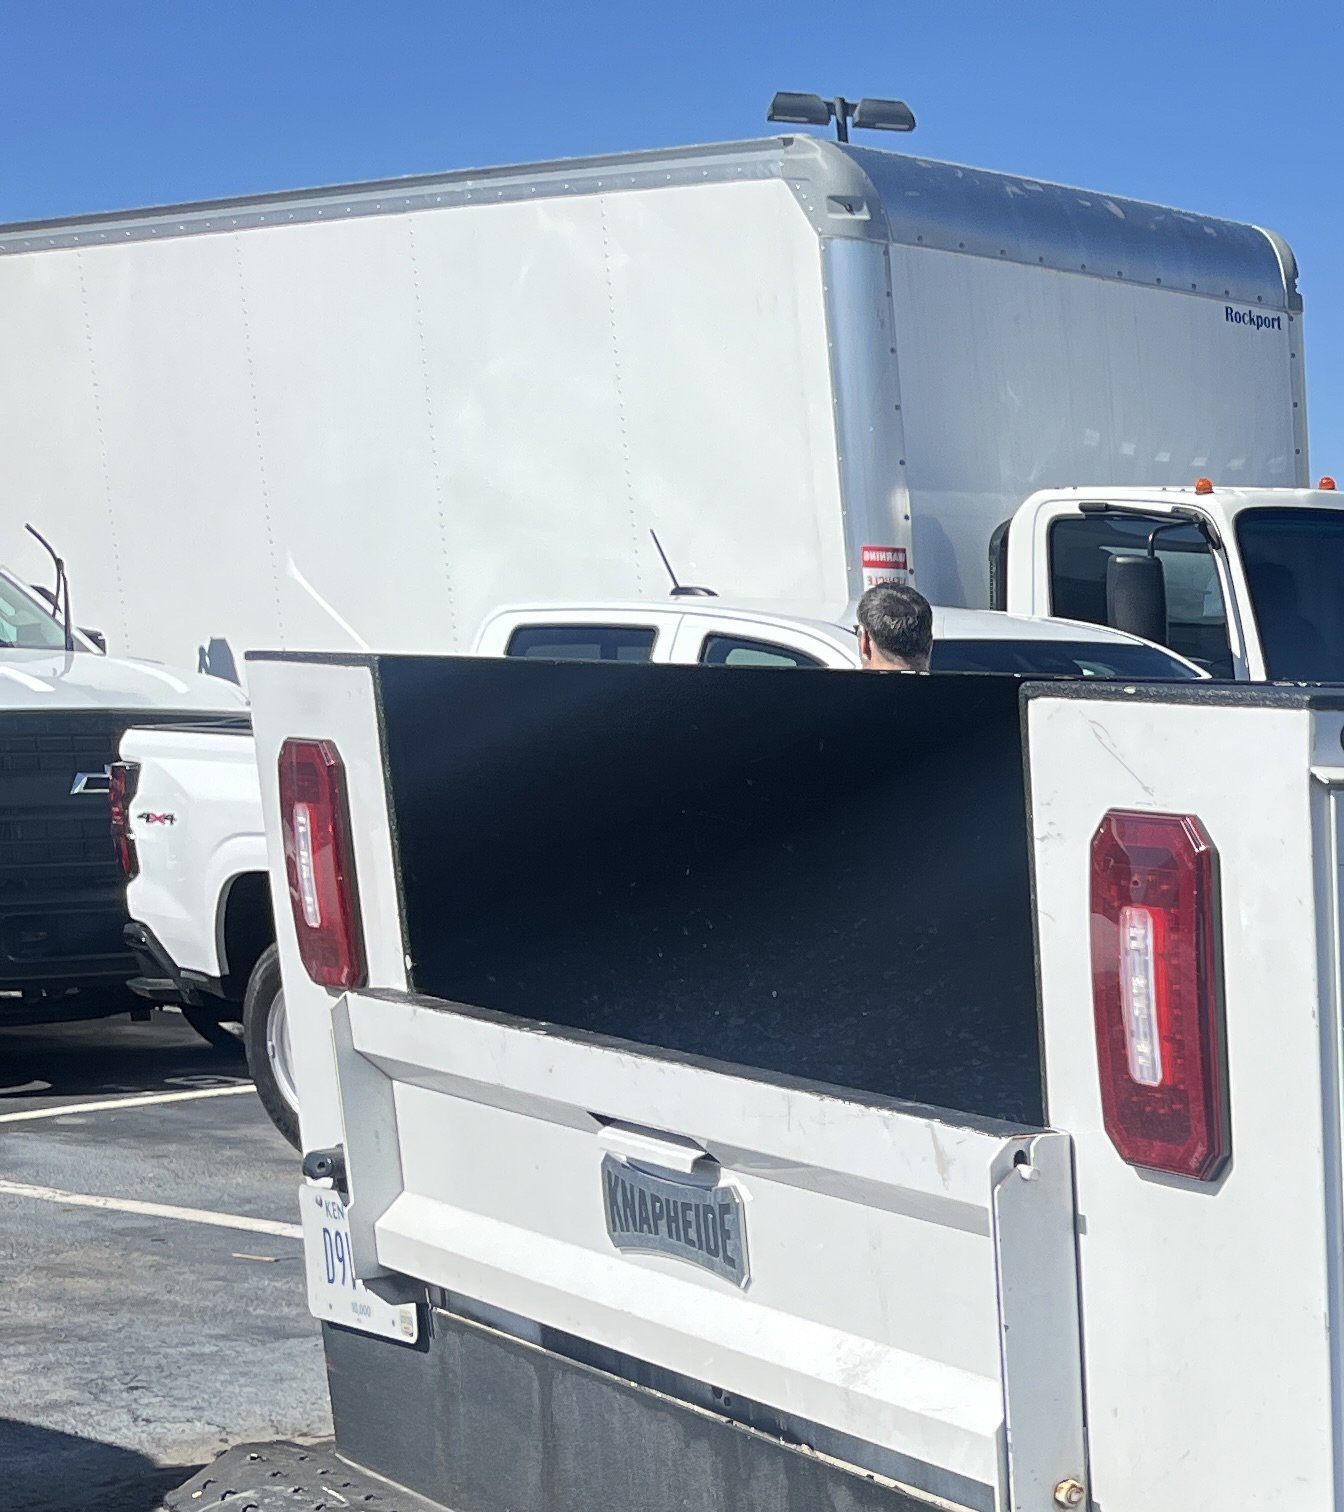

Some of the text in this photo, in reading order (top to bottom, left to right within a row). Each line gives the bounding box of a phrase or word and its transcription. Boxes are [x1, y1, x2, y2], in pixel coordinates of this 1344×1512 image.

[1224, 306, 1282, 331] Rockport
[606, 1169, 737, 1270] KNAPHEIDE
[322, 1227, 357, 1291] D9
